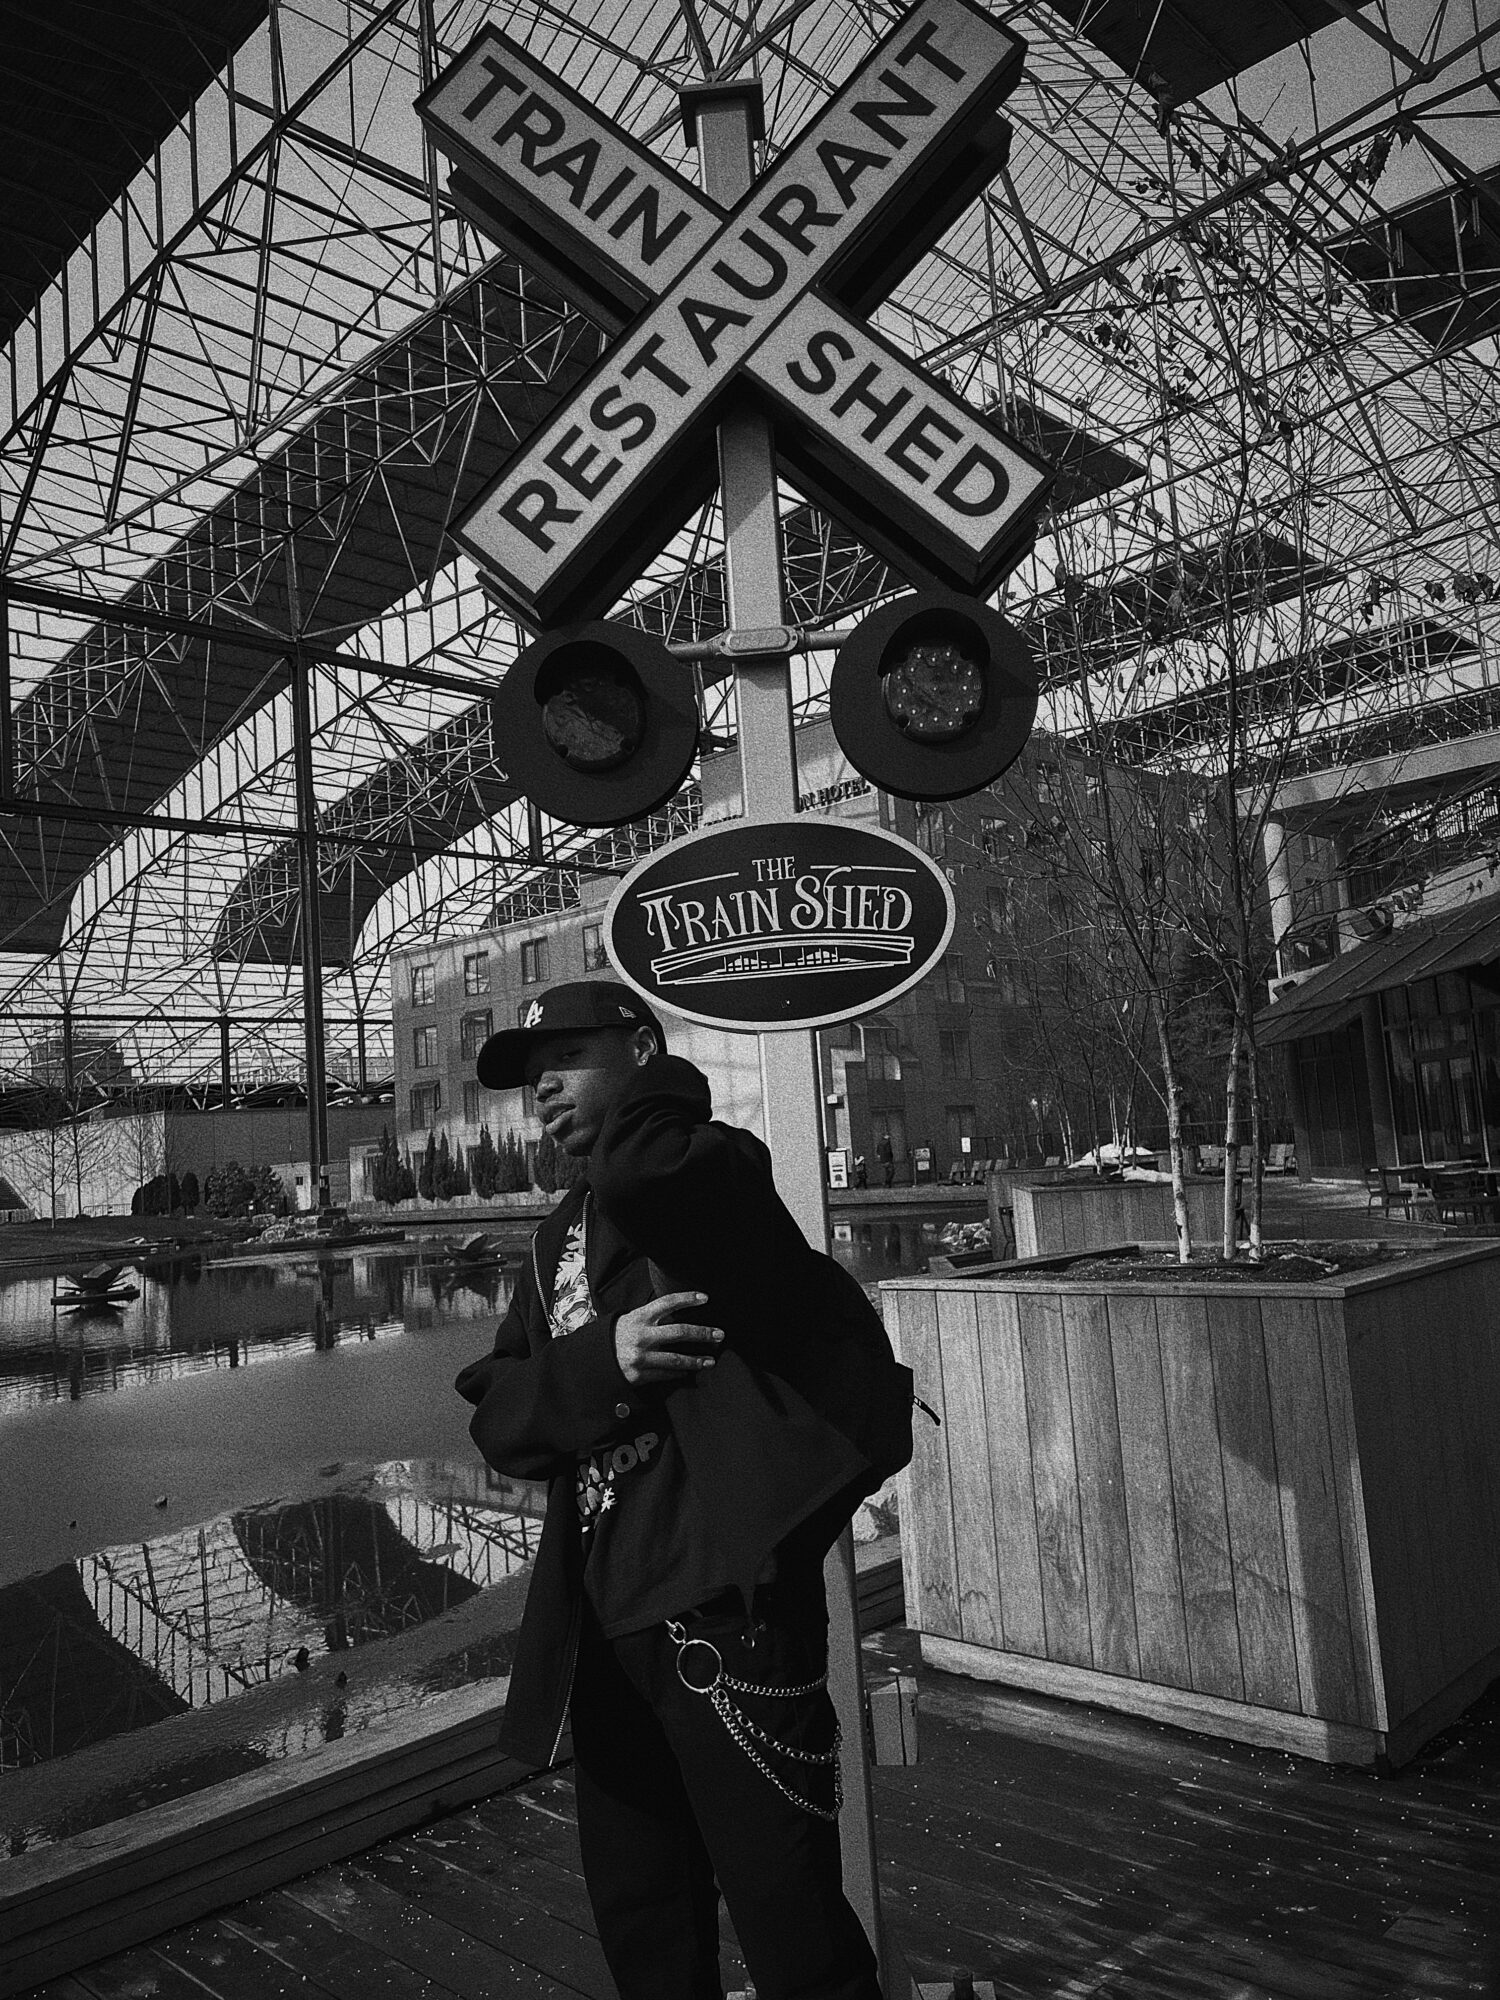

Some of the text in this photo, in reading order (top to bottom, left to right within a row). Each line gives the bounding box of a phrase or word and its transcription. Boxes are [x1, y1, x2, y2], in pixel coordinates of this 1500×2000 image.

[458, 55, 1010, 517] TRAIN SHED
[497, 19, 968, 553] RESTAURANT
[817, 776, 871, 806] HOTEL
[639, 866, 913, 953] TRAIN SHED
[751, 856, 797, 882] THE
